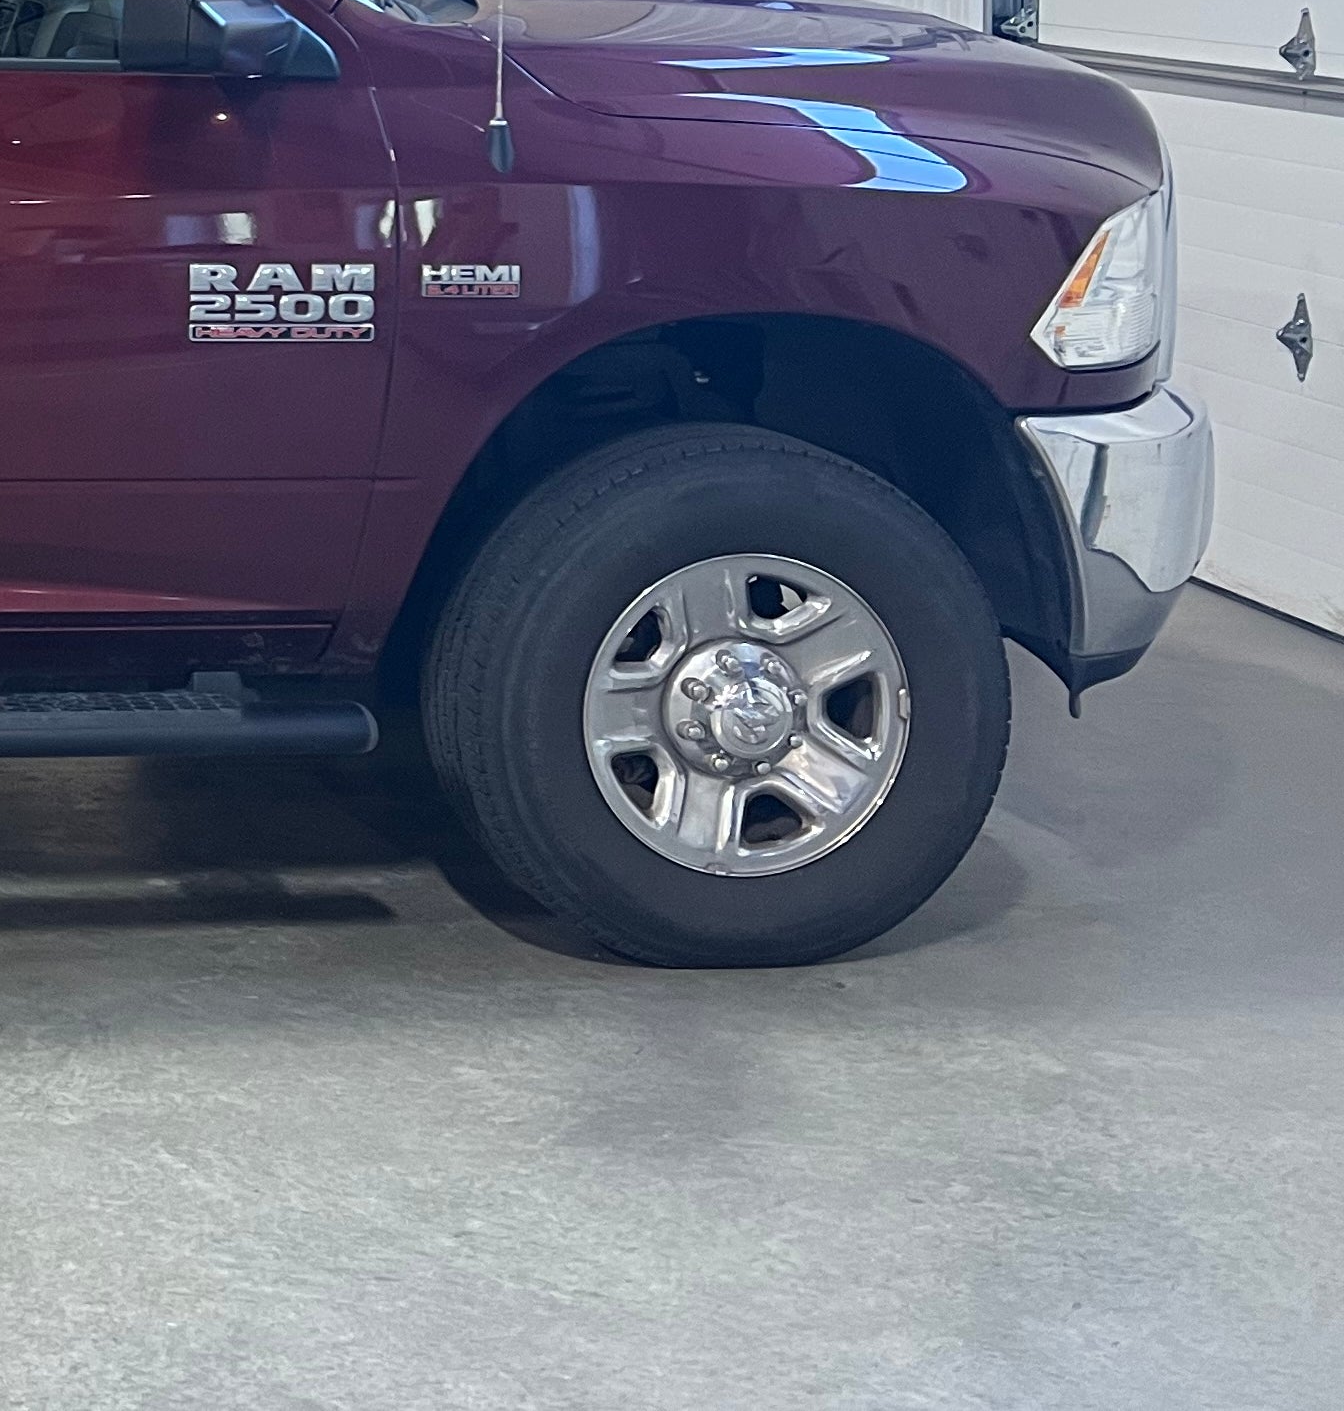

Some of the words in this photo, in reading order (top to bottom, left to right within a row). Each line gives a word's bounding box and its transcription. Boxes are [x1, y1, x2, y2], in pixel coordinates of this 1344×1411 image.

[189, 263, 374, 292] RAM
[422, 264, 520, 282] HEMI
[462, 284, 517, 295] LITER
[189, 293, 374, 322] 2500
[195, 327, 287, 339] HEAVY
[290, 327, 368, 339] DUTY
